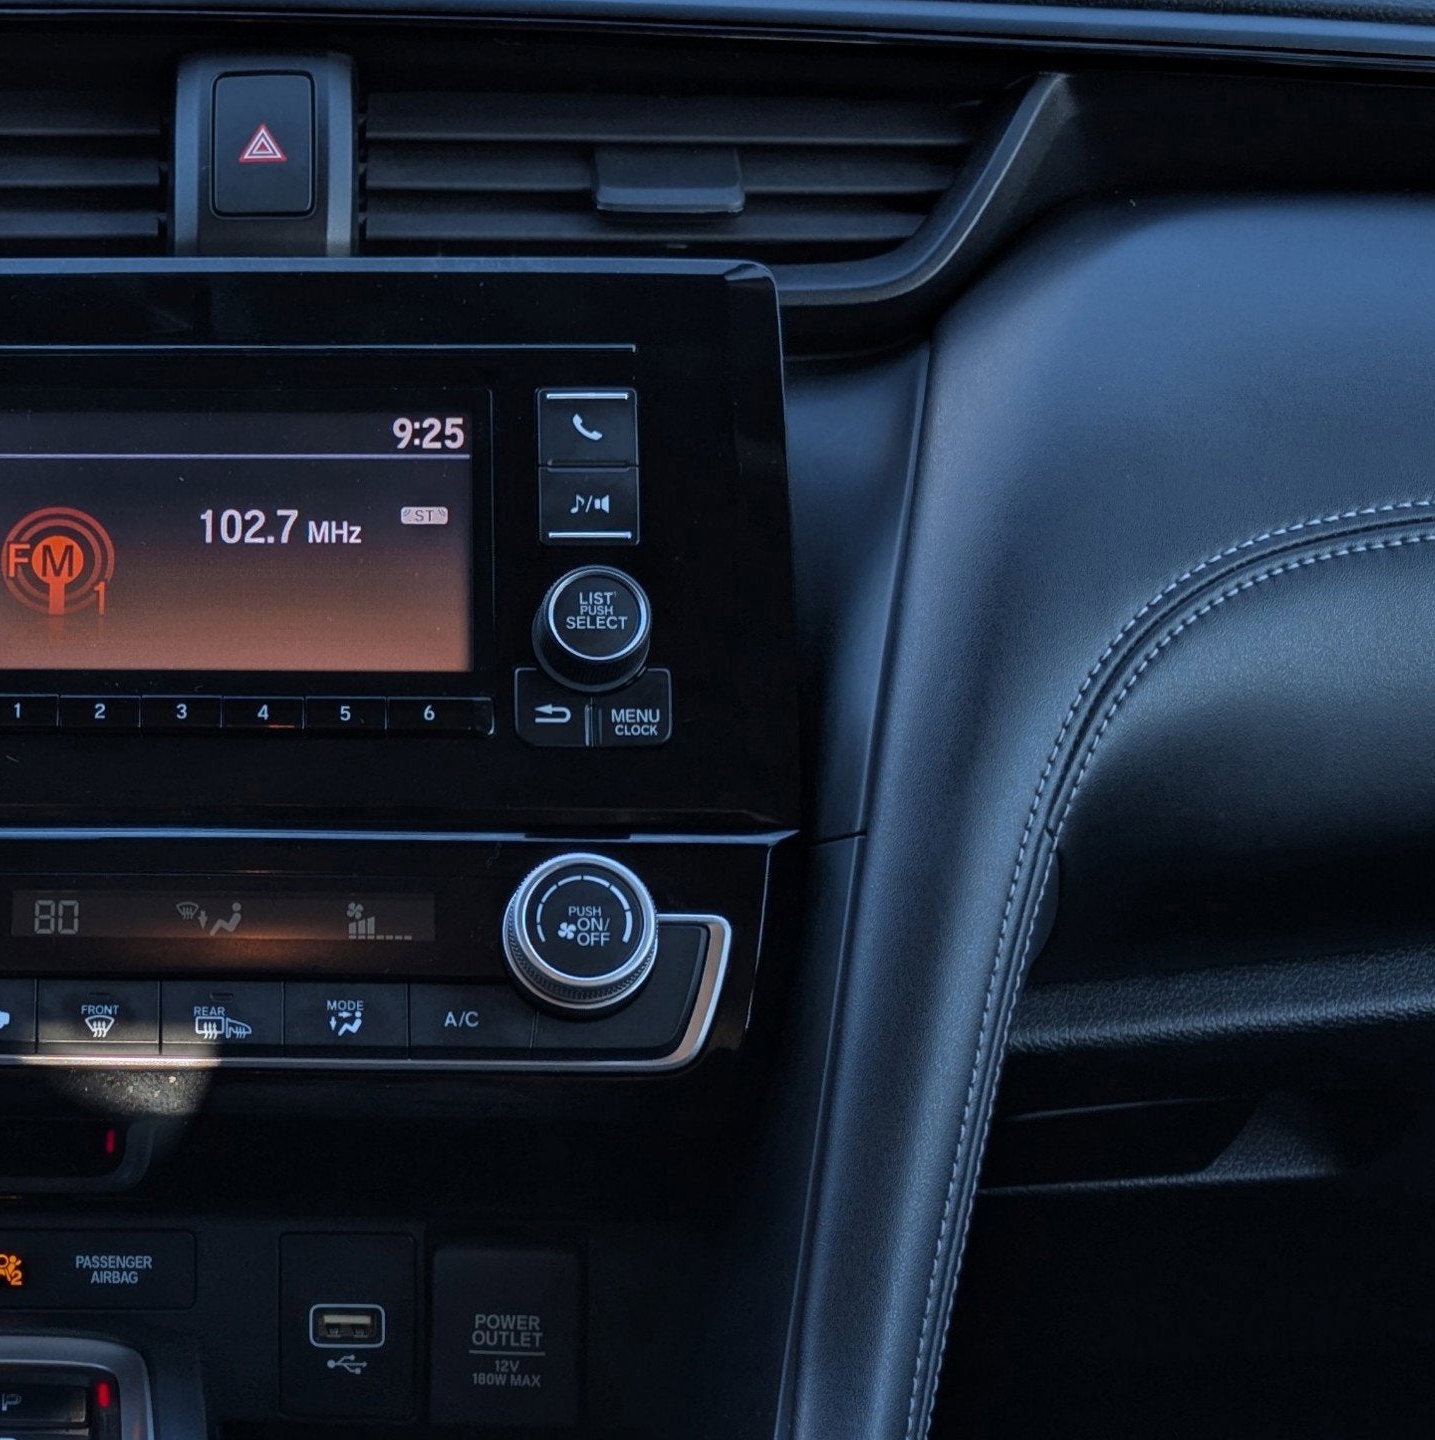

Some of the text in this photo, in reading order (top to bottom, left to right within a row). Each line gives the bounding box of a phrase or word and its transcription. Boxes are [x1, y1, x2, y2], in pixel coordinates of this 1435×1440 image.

[392, 417, 465, 450] 9:25
[414, 508, 434, 523] ST
[200, 509, 362, 545] 102.7 MHz
[7, 543, 74, 579] FM
[578, 591, 613, 606] LIST
[579, 605, 614, 617] PUSH
[565, 616, 628, 631] SELECT
[14, 703, 21, 718] 1
[94, 704, 106, 719] 2
[176, 704, 188, 720] 3
[257, 705, 270, 721] 4
[339, 706, 351, 721] 5
[423, 706, 435, 721] 6
[611, 709, 660, 724] MENU
[615, 724, 659, 737] CLOCK
[34, 899, 79, 936] 80
[568, 906, 602, 918] PUSH
[576, 917, 610, 933] ON/
[576, 932, 610, 947] OFF
[80, 1004, 120, 1016] FRONT
[193, 1006, 226, 1017] REAR
[326, 1000, 364, 1012] MODE
[444, 1011, 480, 1029] A/C
[75, 1255, 153, 1270] PASSENGER
[90, 1270, 139, 1285] AIRBAG
[474, 1314, 541, 1331] POWER
[471, 1330, 543, 1347] OUTLET
[494, 1359, 520, 1373] 12V
[471, 1372, 541, 1388] 180W MAX
[1, 1393, 22, 1411] P
